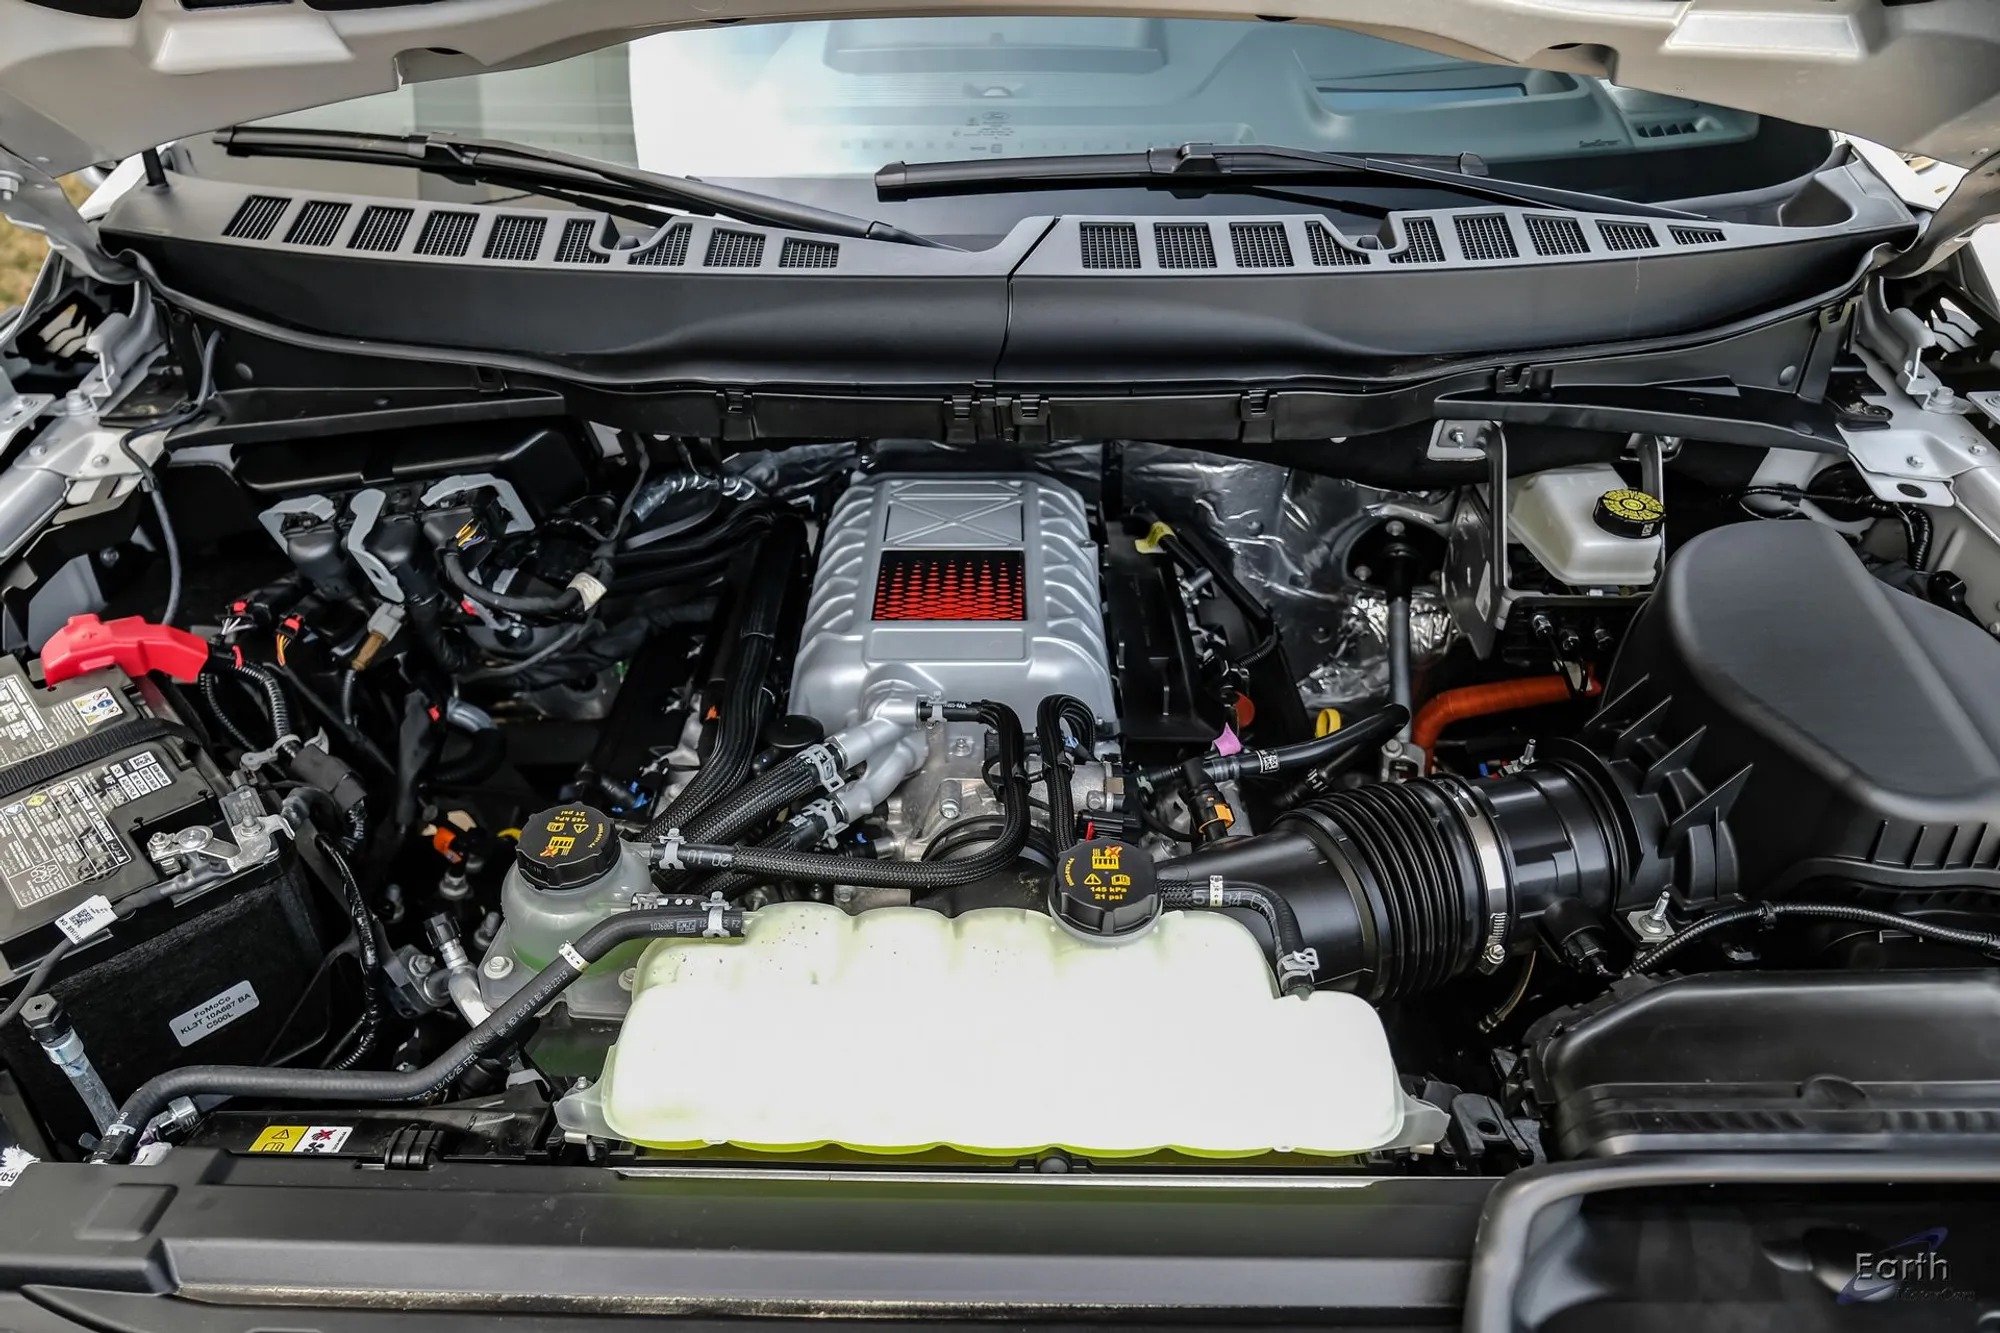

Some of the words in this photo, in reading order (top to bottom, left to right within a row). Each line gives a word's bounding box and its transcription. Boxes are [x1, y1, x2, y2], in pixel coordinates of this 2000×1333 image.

[710, 852, 731, 867] 20
[1108, 893, 1123, 901] psi
[193, 996, 231, 1018] FoMoCo
[180, 1018, 204, 1035] KL3T
[206, 1013, 234, 1030] C500L
